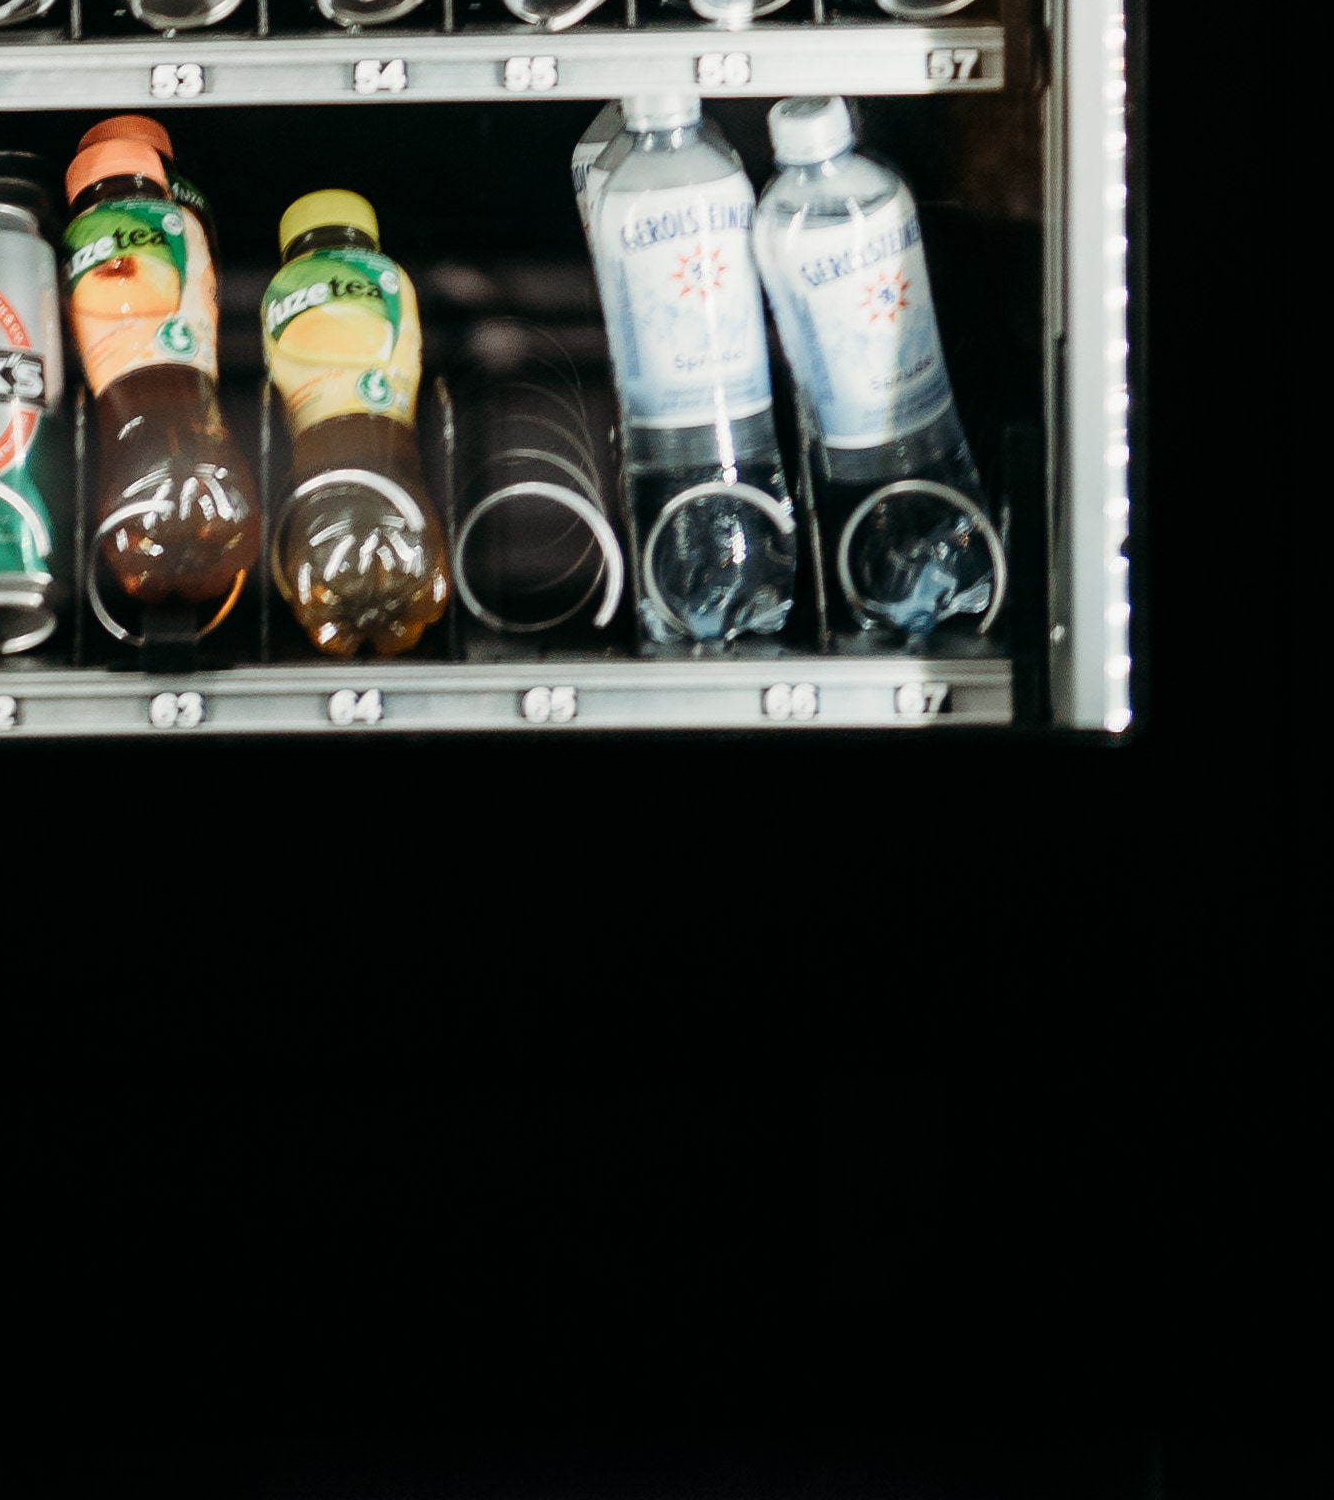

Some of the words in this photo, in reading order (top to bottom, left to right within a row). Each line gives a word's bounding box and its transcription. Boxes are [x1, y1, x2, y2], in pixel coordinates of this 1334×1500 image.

[151, 64, 205, 98] 53
[353, 60, 408, 94] 54
[504, 56, 559, 91] 55
[696, 53, 752, 87] 56
[929, 49, 979, 81] 57
[150, 692, 206, 728] 63
[327, 689, 384, 725] 64
[522, 686, 578, 723] 65
[765, 684, 820, 721] 66
[896, 682, 950, 717] 67
